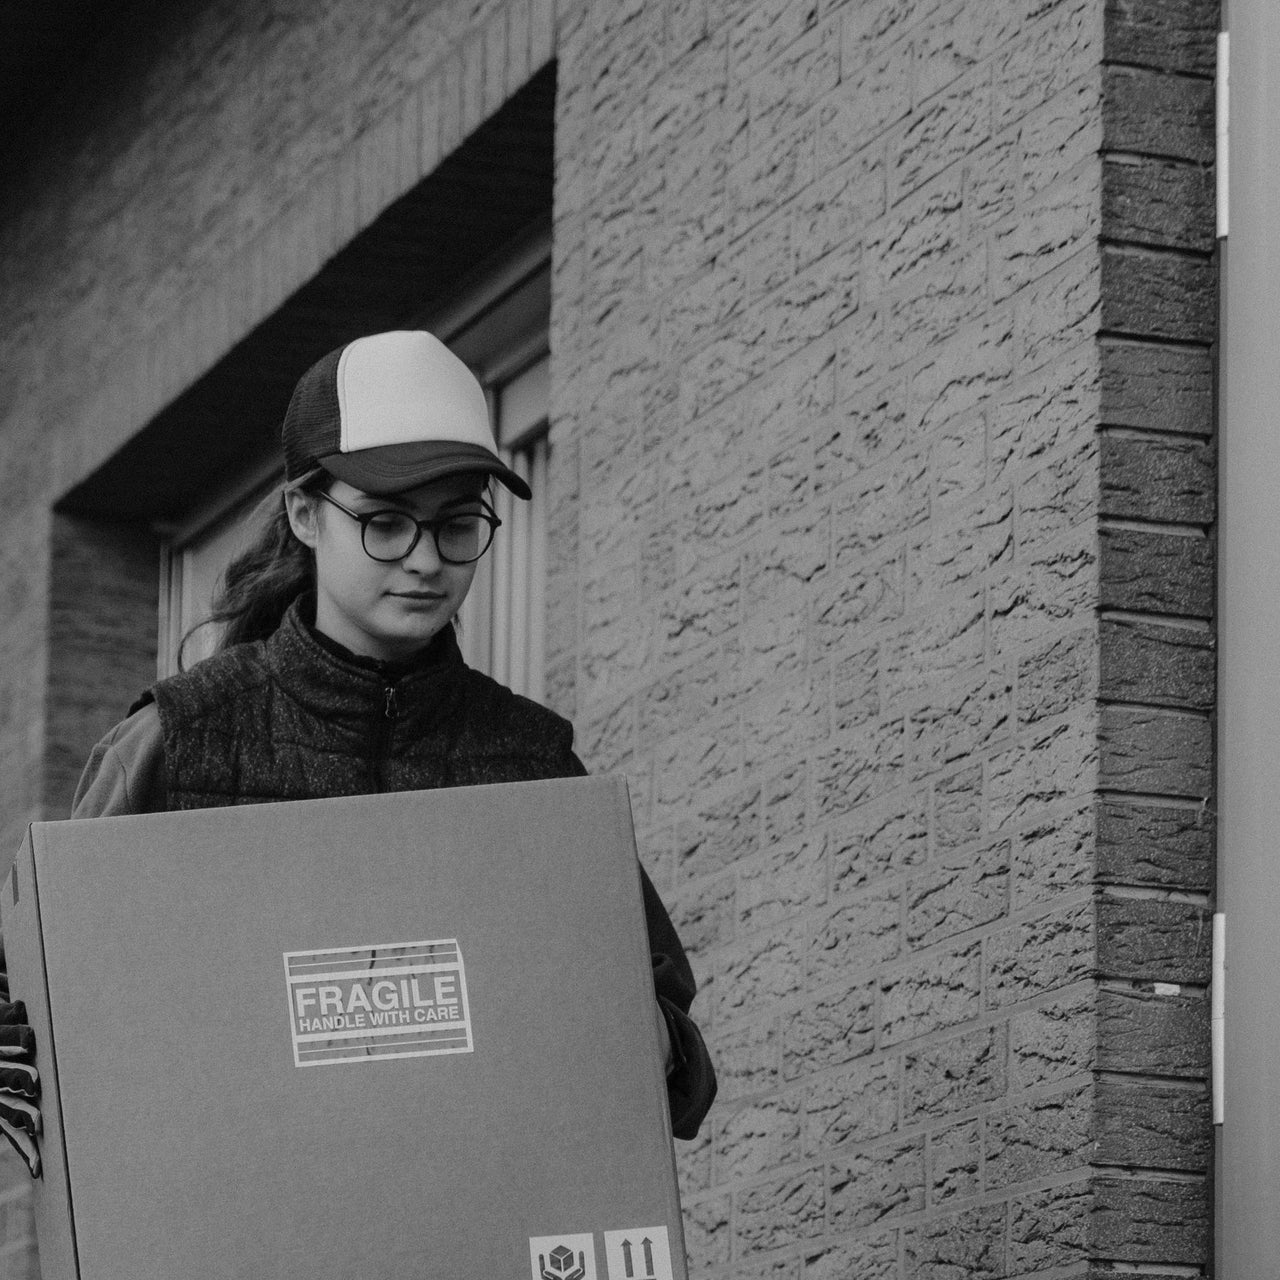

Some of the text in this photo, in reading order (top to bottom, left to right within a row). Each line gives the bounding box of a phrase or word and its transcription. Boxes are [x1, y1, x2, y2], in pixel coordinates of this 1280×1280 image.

[295, 975, 458, 1018] FRAGILE
[299, 1005, 460, 1032] HANDLE WITH CARE
